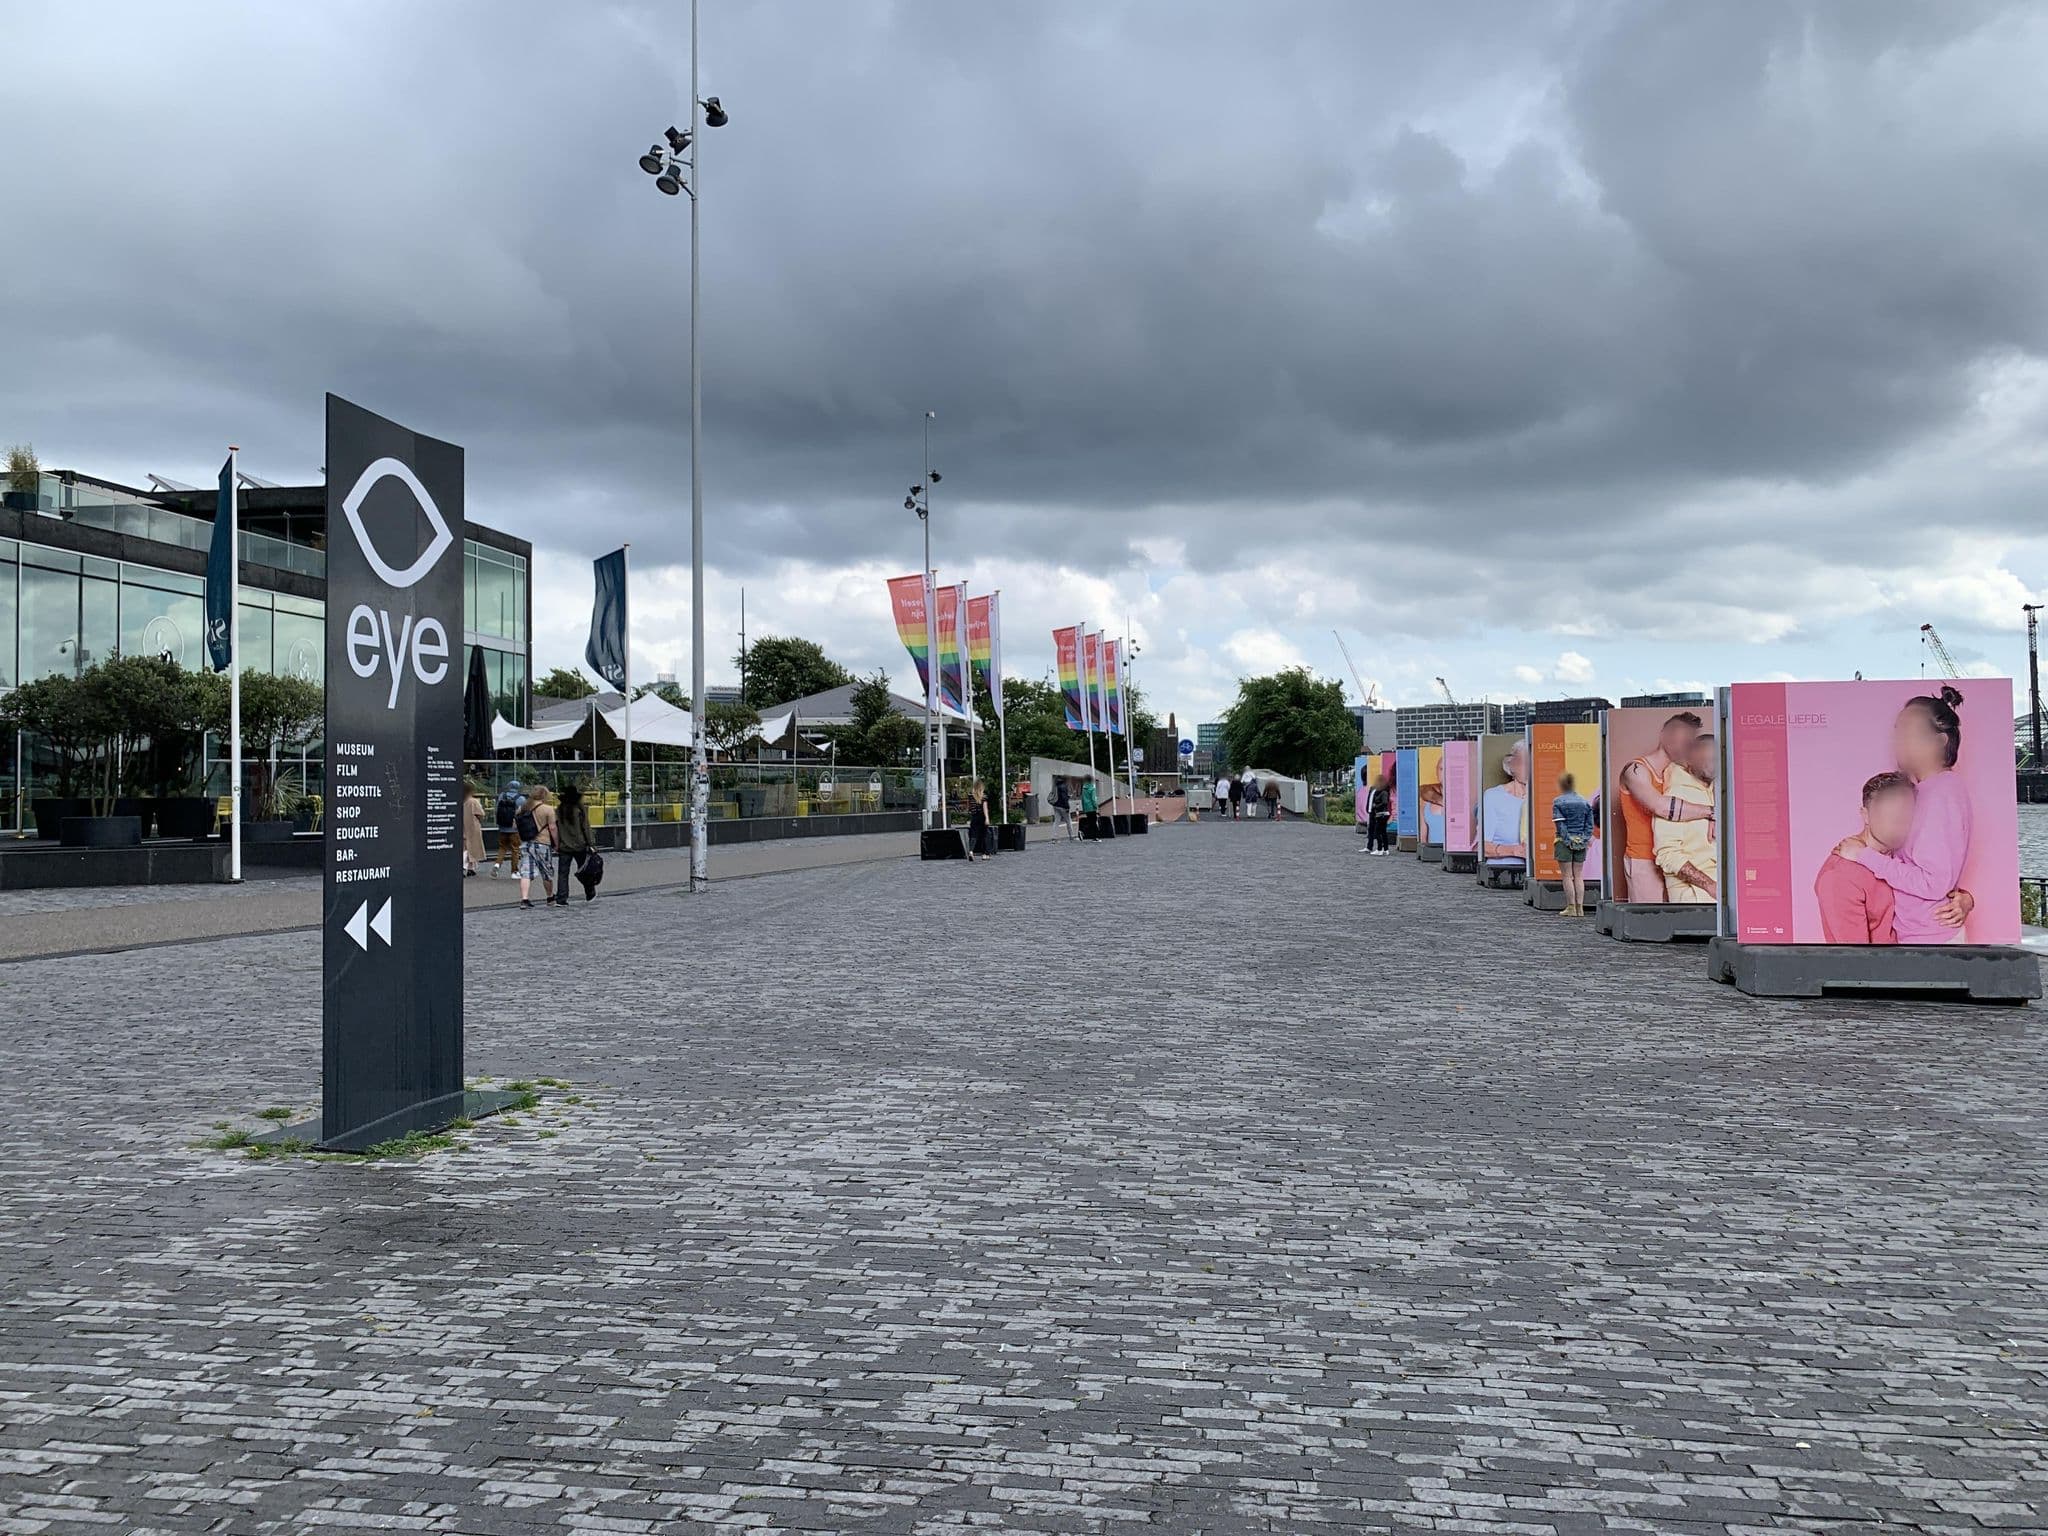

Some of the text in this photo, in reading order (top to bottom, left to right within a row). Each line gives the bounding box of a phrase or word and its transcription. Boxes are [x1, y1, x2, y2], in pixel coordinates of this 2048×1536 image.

[346, 604, 449, 709] eye
[1740, 713, 1828, 725] LEGALE LIEFDE
[336, 743, 374, 756] MUSEUM
[336, 764, 358, 776] FILM
[336, 807, 361, 819] SHOP
[336, 826, 379, 840] EDUCATIE
[336, 849, 358, 862] BAR-
[336, 866, 391, 883] RESTAURANT
